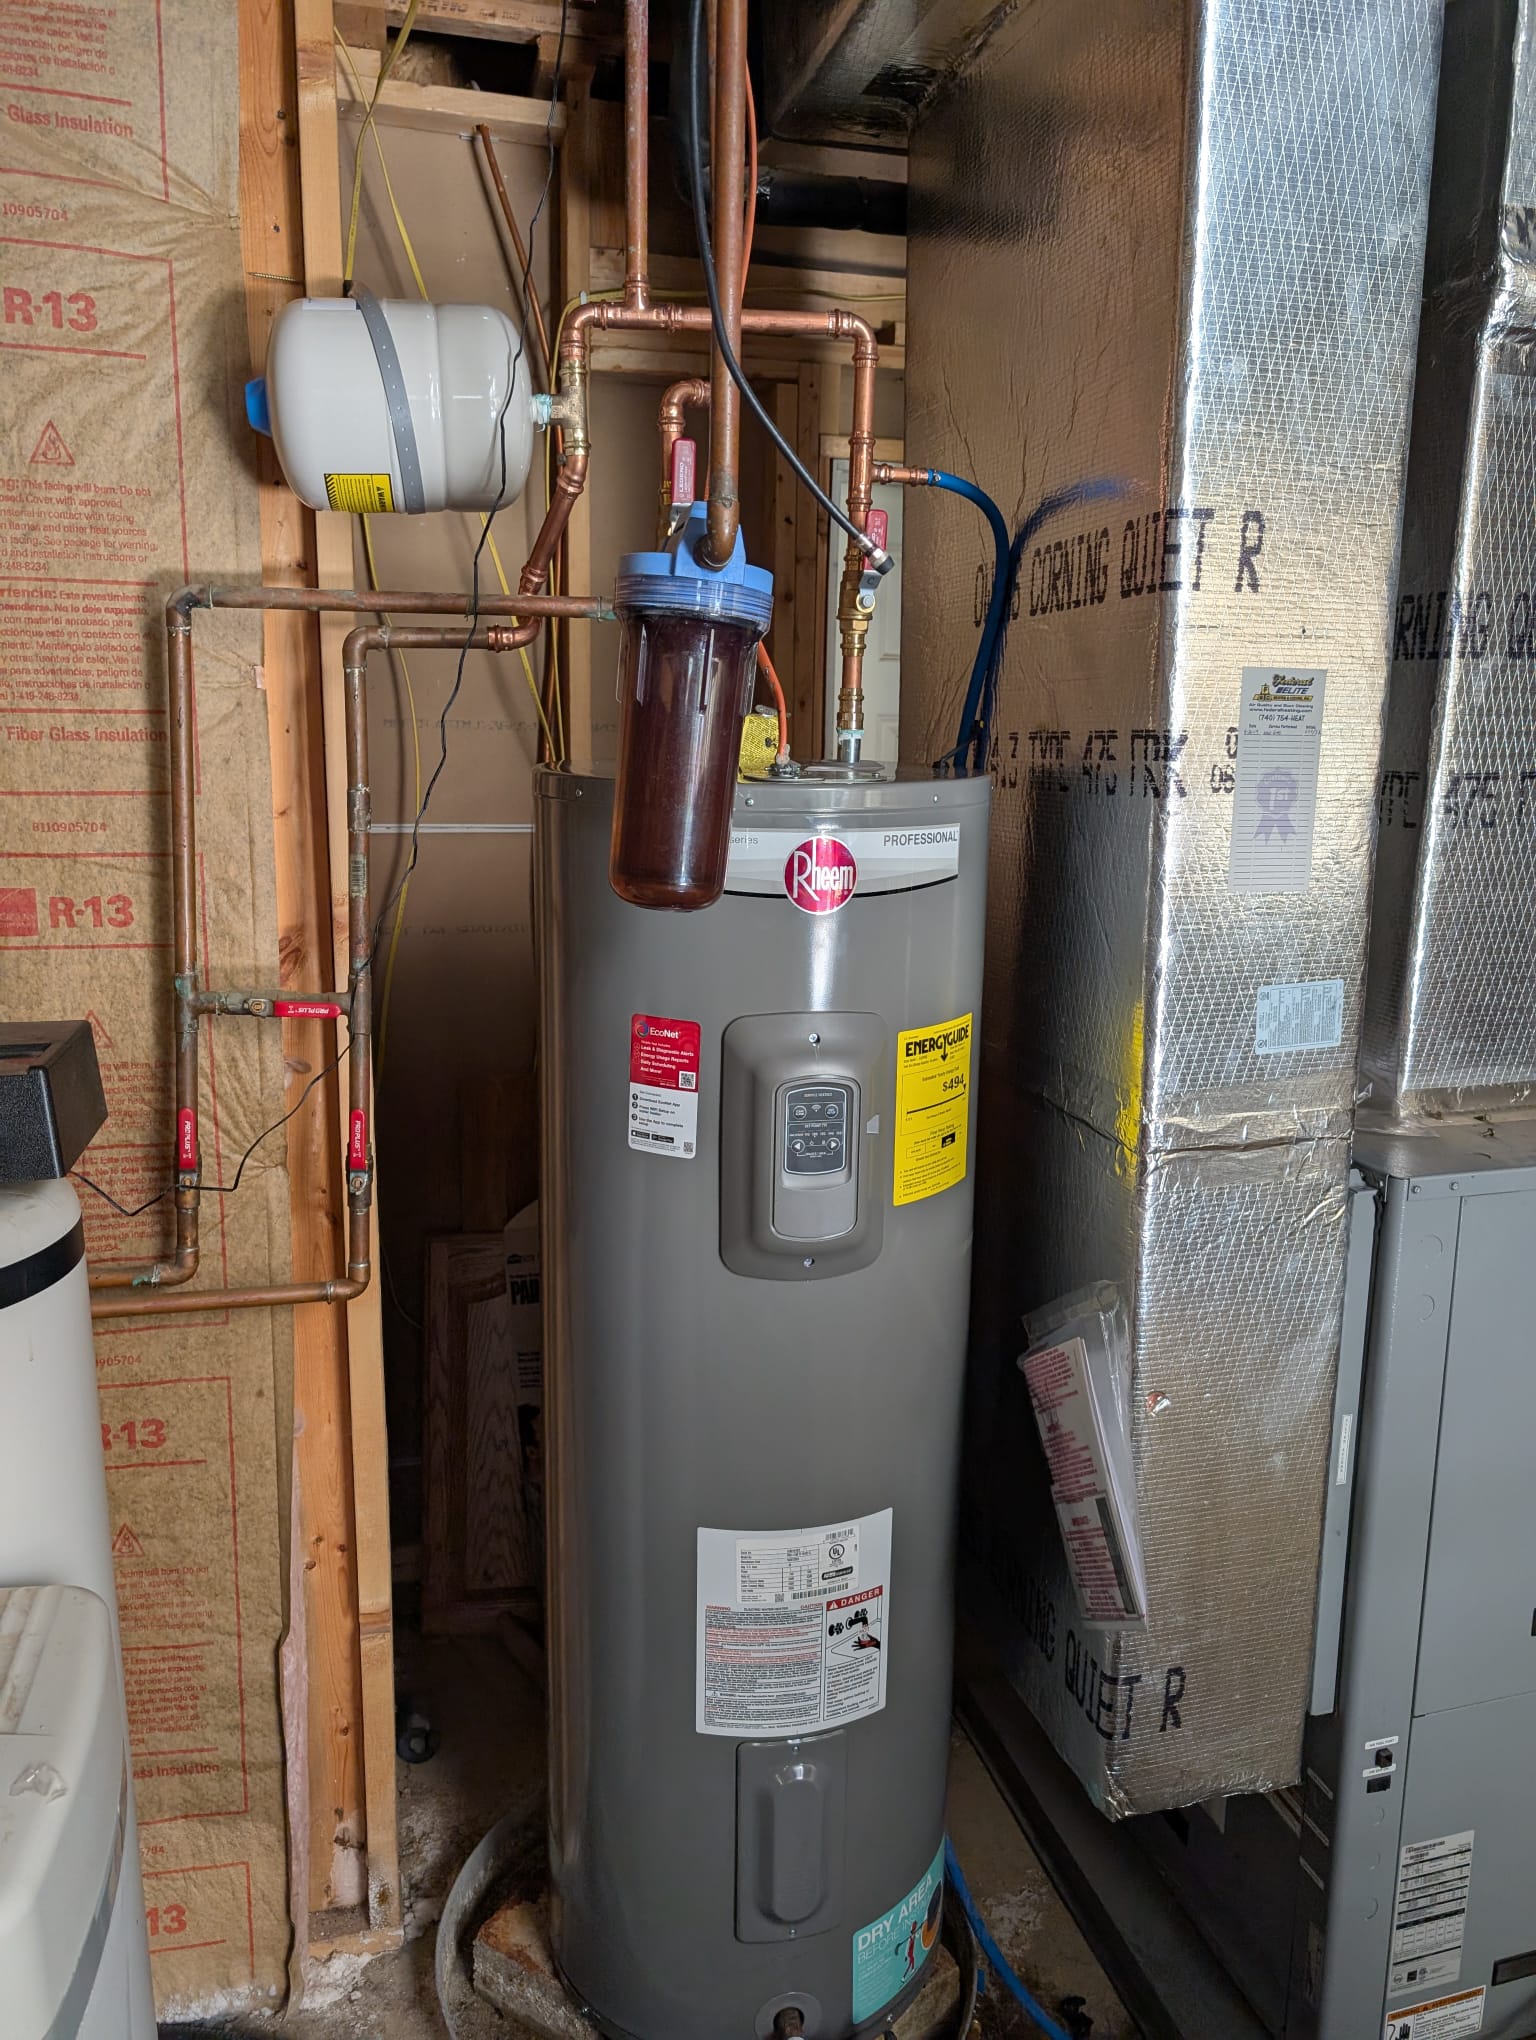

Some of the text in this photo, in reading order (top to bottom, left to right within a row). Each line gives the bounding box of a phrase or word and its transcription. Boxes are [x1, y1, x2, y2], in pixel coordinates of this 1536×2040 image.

[8, 103, 133, 138] Glass Insulation
[3, 287, 98, 332] R-13
[1029, 527, 1110, 617] CORNING
[1119, 508, 1215, 599] QUIET
[1234, 510, 1266, 593] R
[6, 726, 167, 742] Fiber Glass Insulation
[884, 831, 958, 847] PROFESSIONAL
[793, 838, 854, 902] Rheem
[49, 893, 134, 928] R-13
[650, 1026, 679, 1039] EcoNet
[905, 1024, 969, 1060] ENERGYGUIDE
[942, 1073, 964, 1092] $494
[840, 1588, 880, 1606] DANGER
[1064, 1628, 1142, 1740] QUIET
[1159, 1666, 1187, 1733] R
[157, 1764, 220, 1777] Insulation
[857, 1914, 894, 1951] DRY
[898, 1874, 933, 1924] AREA
